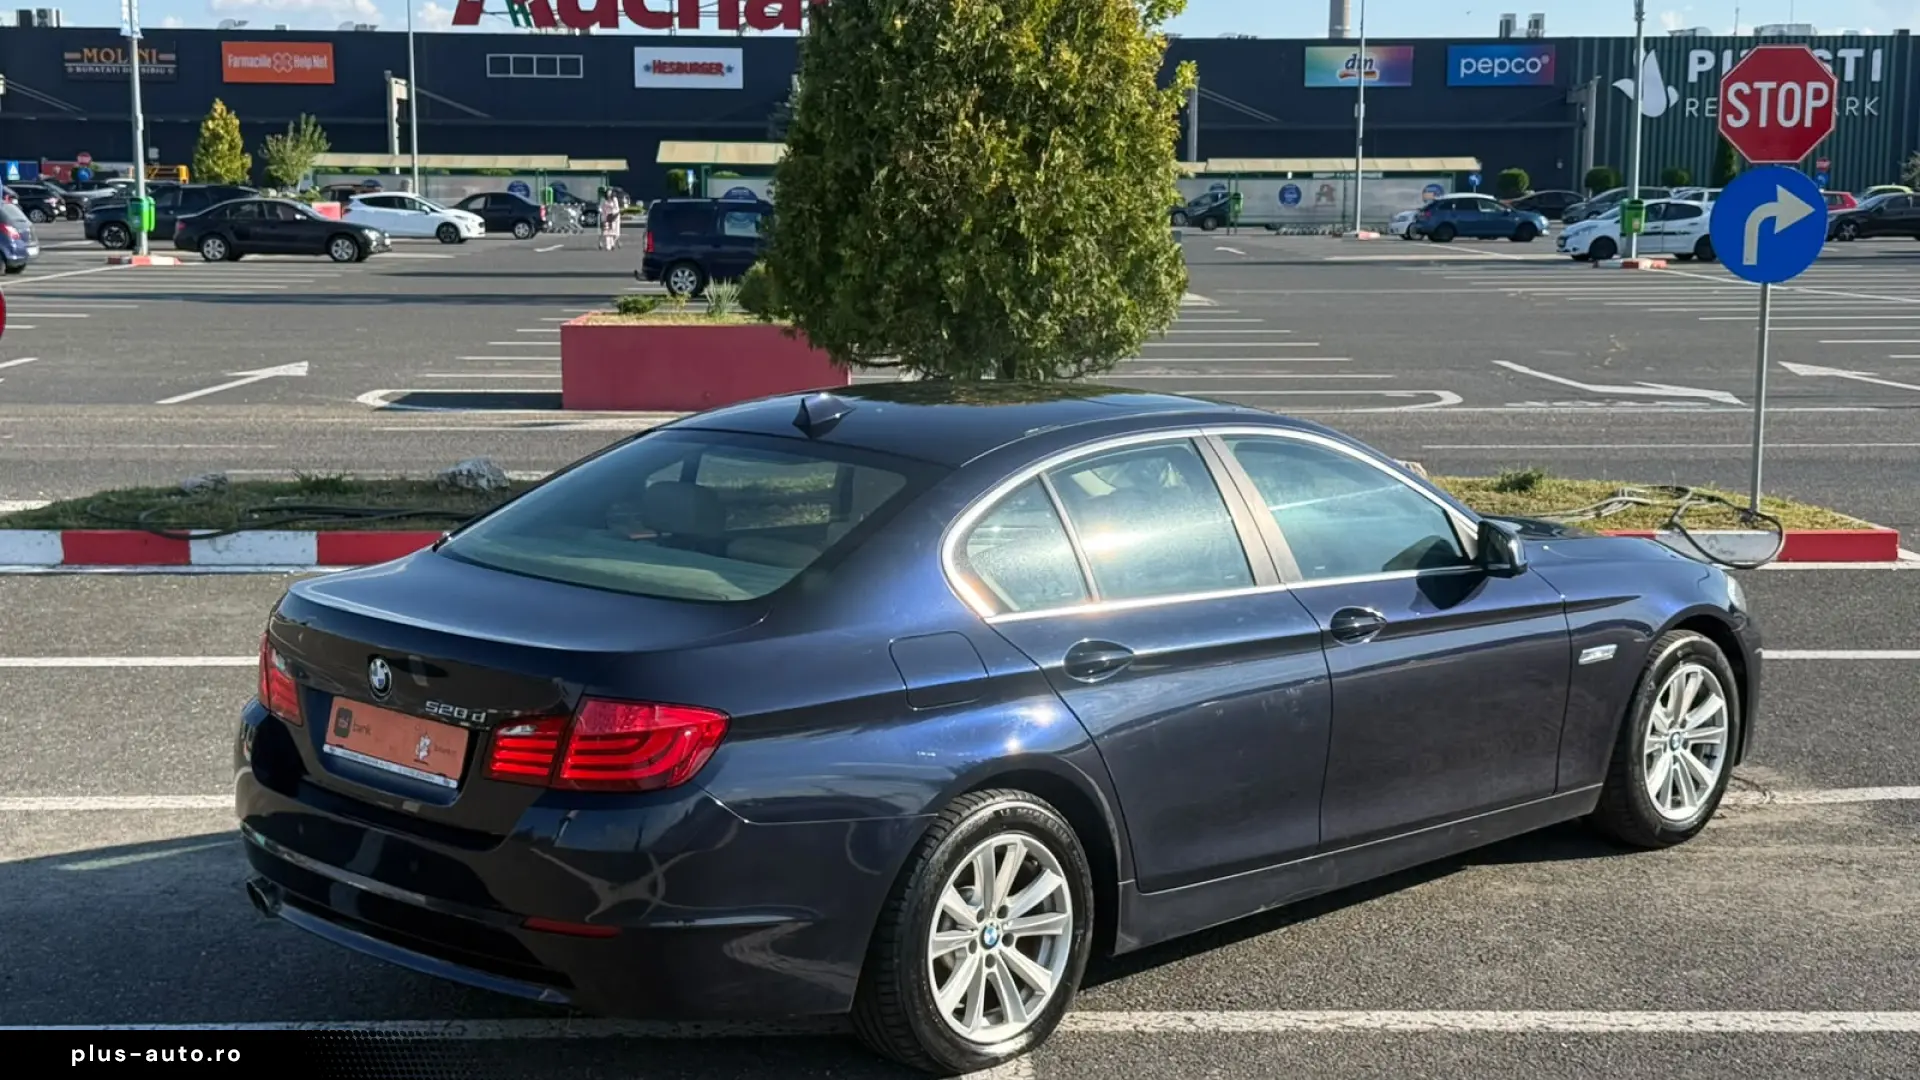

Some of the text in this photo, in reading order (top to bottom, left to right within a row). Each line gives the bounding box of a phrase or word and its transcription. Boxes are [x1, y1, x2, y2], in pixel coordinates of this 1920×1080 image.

[451, 0, 807, 31] ucha
[82, 48, 157, 64] MOLNI
[1345, 53, 1374, 70] dm
[1460, 56, 1542, 78] pepco
[1687, 49, 1882, 82] PITI
[652, 59, 725, 77] HESBURGER
[1726, 81, 1829, 128] STOP
